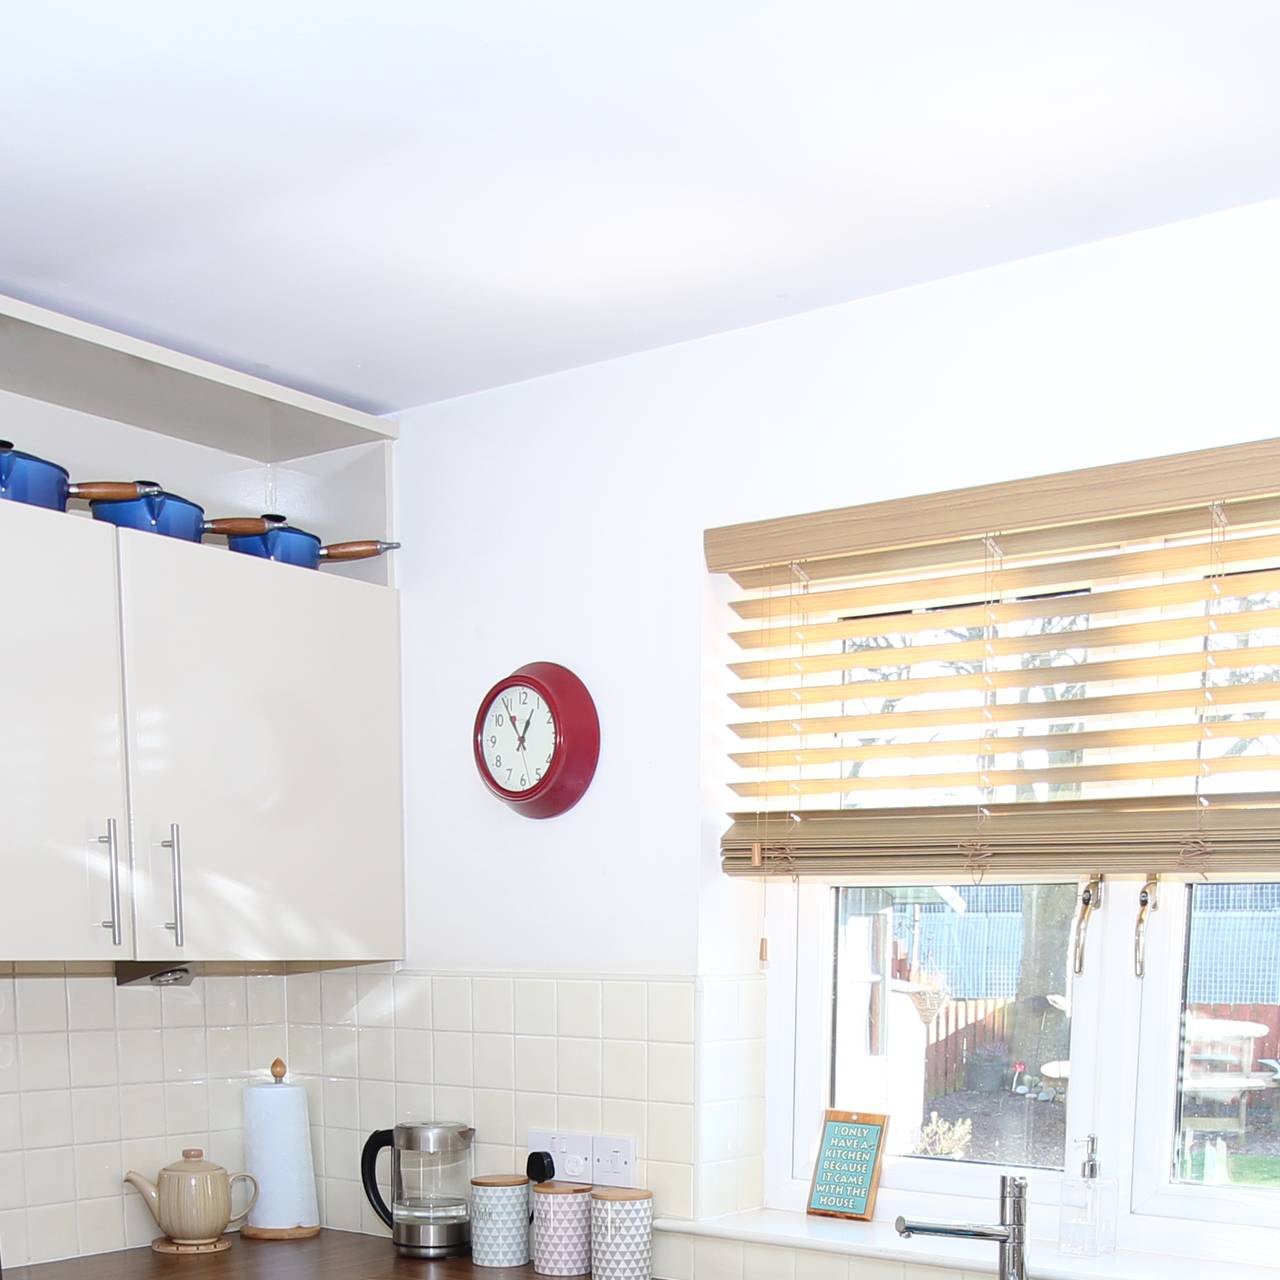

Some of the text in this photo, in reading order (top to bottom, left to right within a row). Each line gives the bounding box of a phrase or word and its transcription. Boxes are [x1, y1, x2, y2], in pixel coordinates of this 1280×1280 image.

[519, 691, 528, 705] 12
[495, 714, 504, 727] 10
[490, 735, 497, 748] 9
[495, 755, 502, 768] 8
[506, 768, 513, 781] 7
[520, 774, 526, 787] 6
[841, 1127, 869, 1136] ONLY
[830, 1138, 859, 1149] HAVE
[824, 1149, 870, 1161] KITCHEN
[823, 1160, 868, 1173] BECAUSE
[822, 1172, 864, 1185] IT CAME
[816, 1184, 867, 1198] WITH THE
